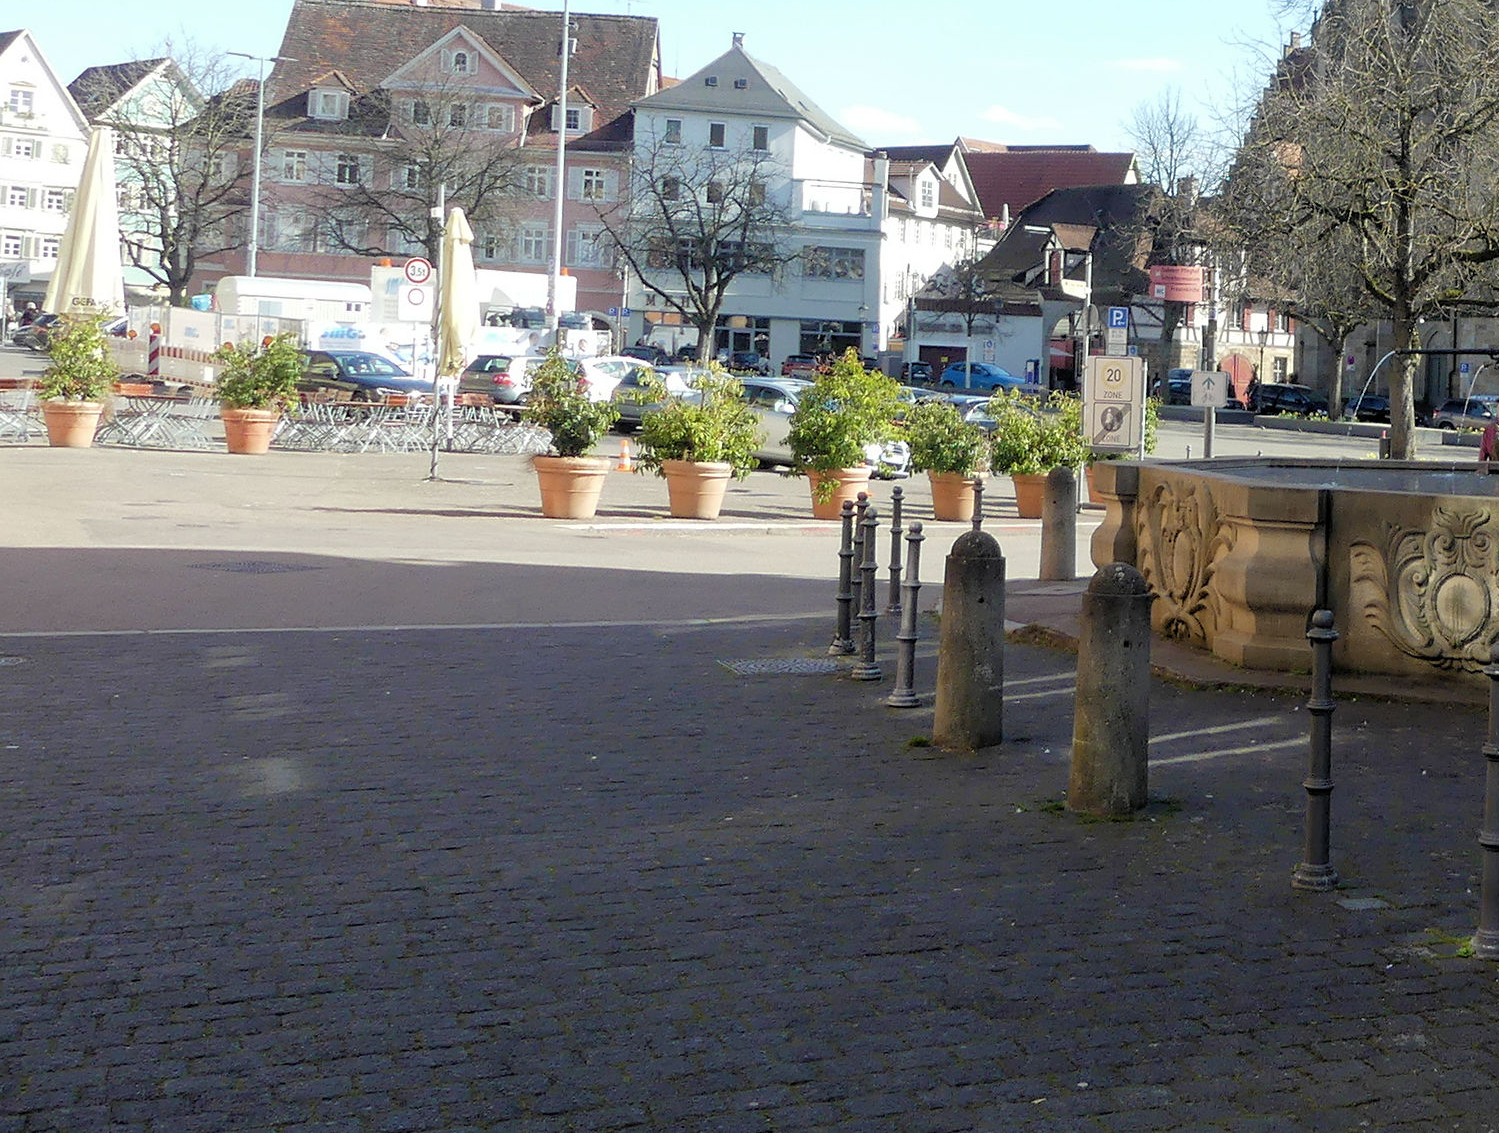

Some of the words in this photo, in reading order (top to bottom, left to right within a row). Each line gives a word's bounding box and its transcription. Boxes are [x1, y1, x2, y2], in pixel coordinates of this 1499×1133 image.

[1112, 310, 1124, 326] P
[1106, 368, 1122, 382] 20
[1103, 390, 1123, 399] ZONE
